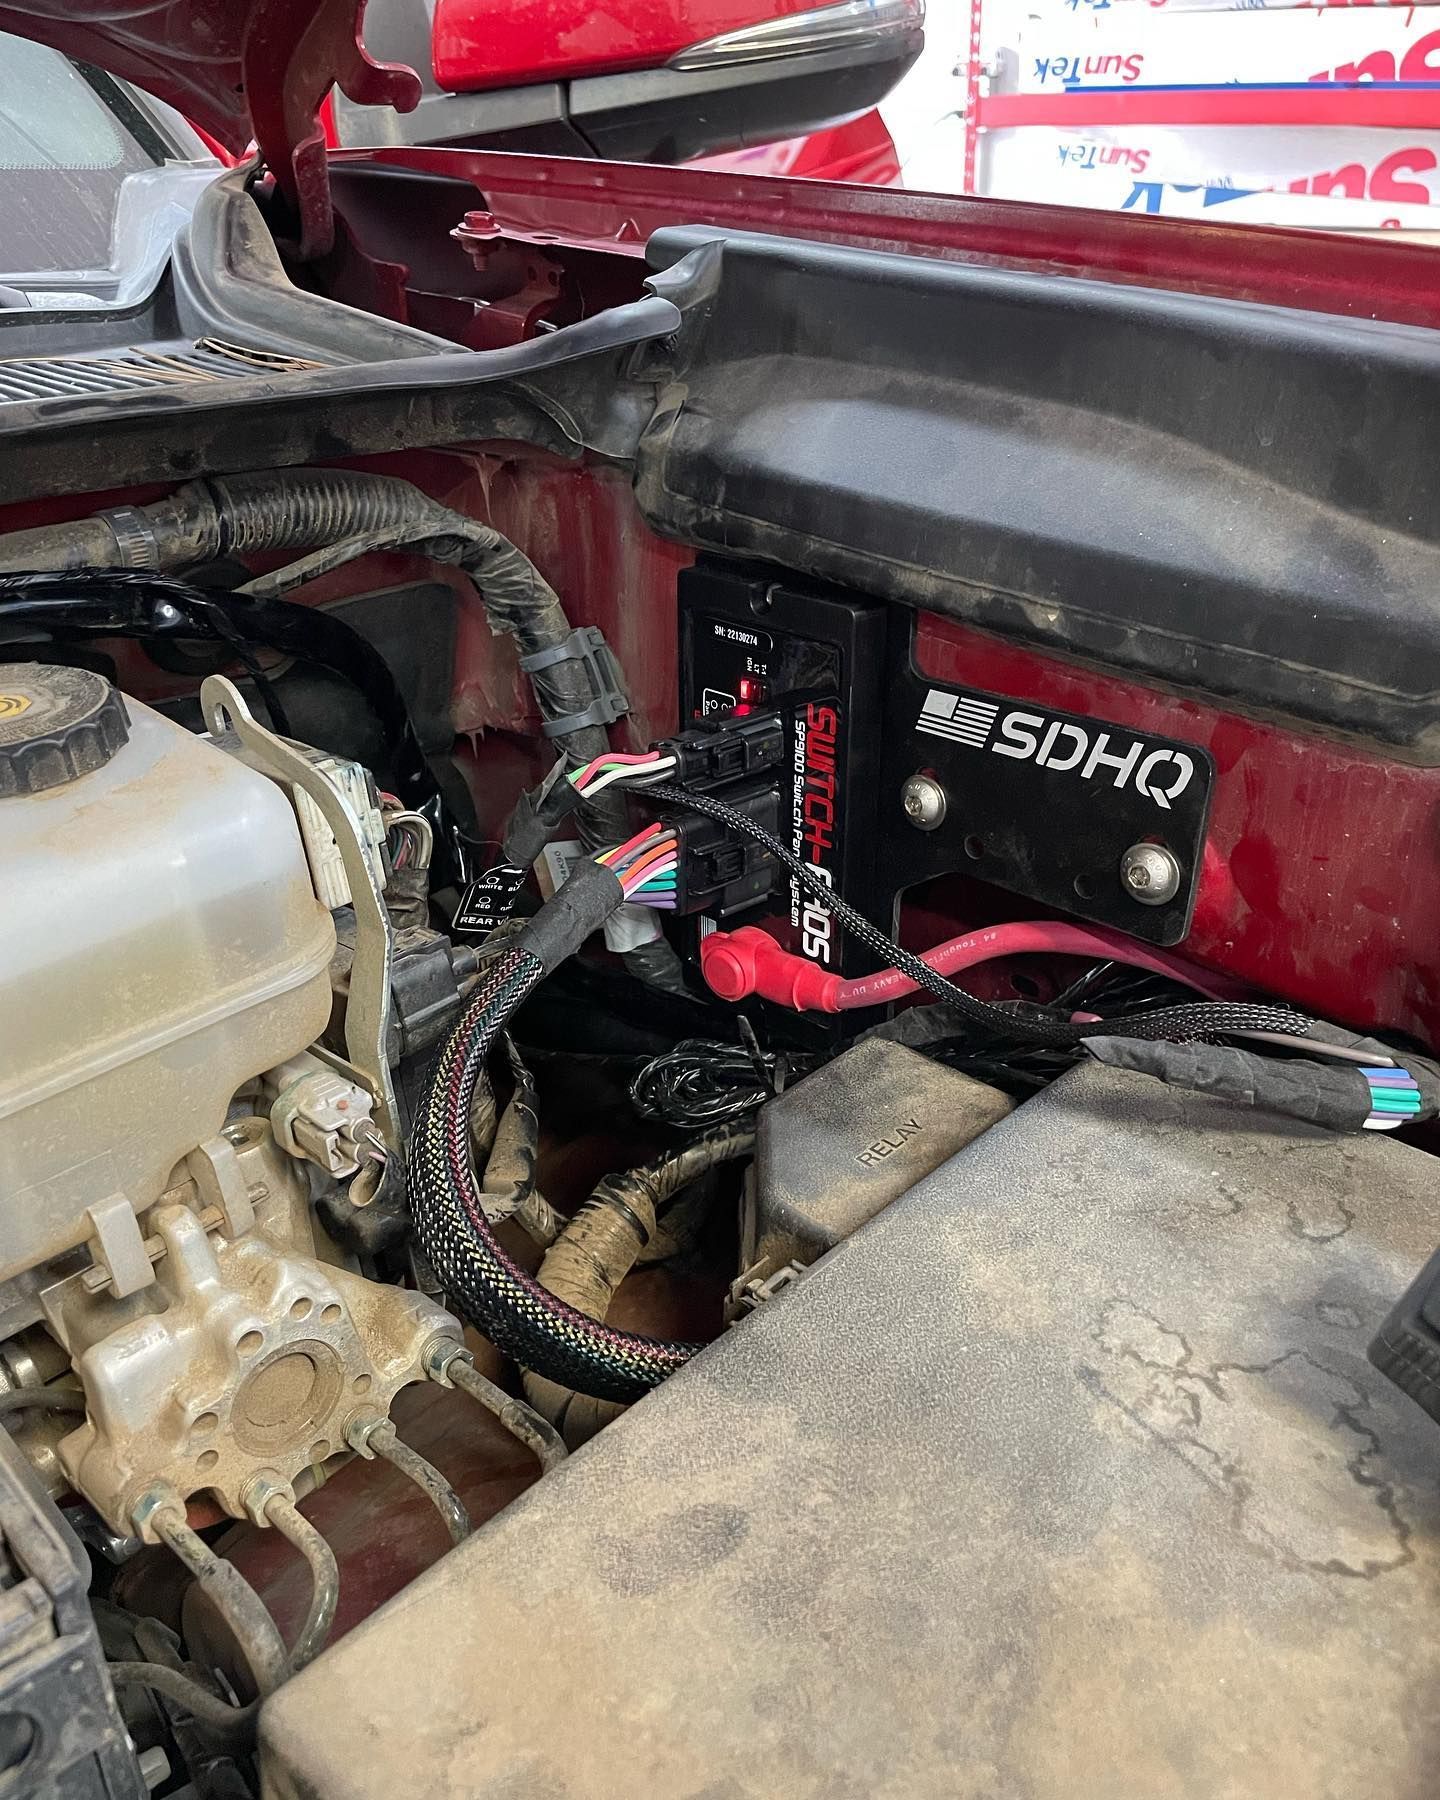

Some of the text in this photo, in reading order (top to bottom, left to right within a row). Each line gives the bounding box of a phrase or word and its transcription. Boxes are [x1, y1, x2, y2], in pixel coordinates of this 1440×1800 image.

[1033, 54, 1144, 84] SunTek
[1058, 145, 1151, 173] SunTek
[714, 624, 758, 646] SN: 22130274
[794, 719, 806, 773] SP9100
[991, 711, 1194, 809] SDHQ
[793, 773, 805, 827] Switch
[460, 916, 493, 926] REAR
[789, 874, 801, 928] ystem
[855, 1118, 923, 1168] RELAY
